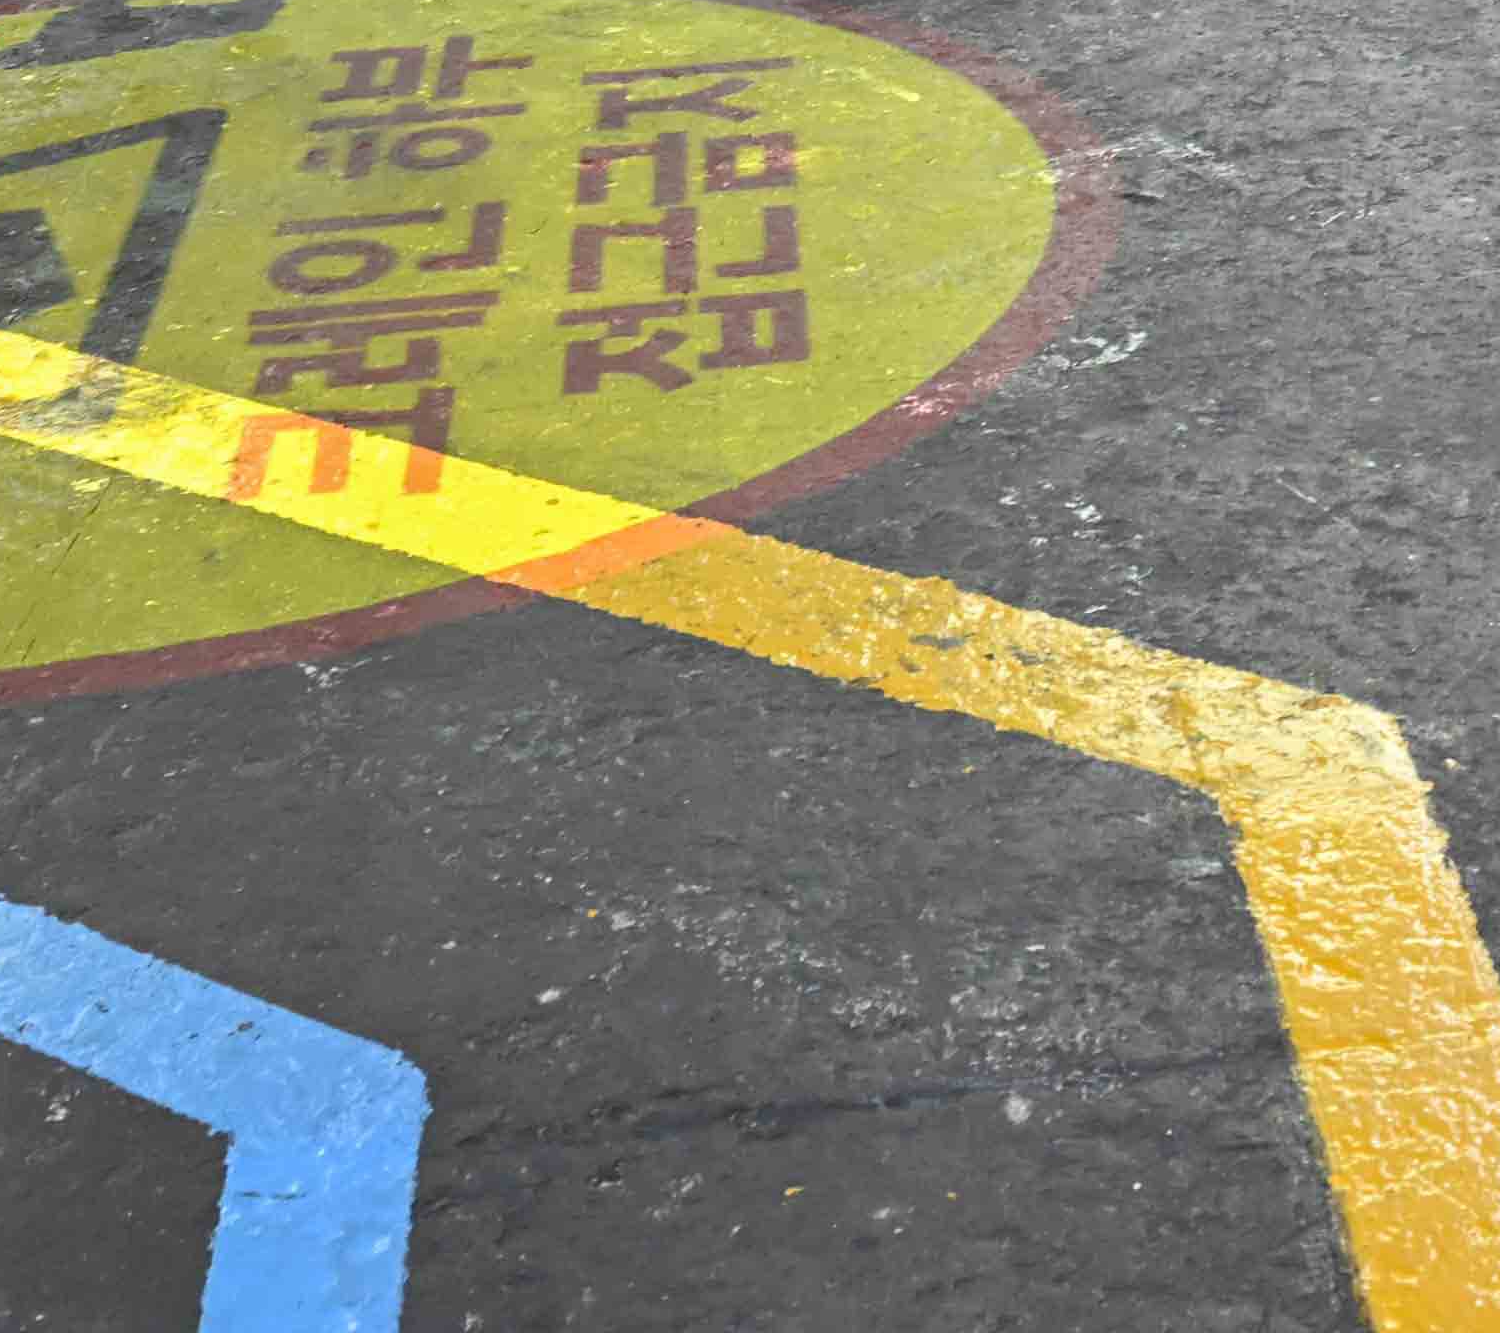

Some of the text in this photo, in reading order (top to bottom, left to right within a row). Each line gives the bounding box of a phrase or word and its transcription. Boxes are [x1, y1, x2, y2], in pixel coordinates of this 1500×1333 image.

[227, 33, 534, 503] 크레인 하부
[554, 51, 812, 397] 접근금지
